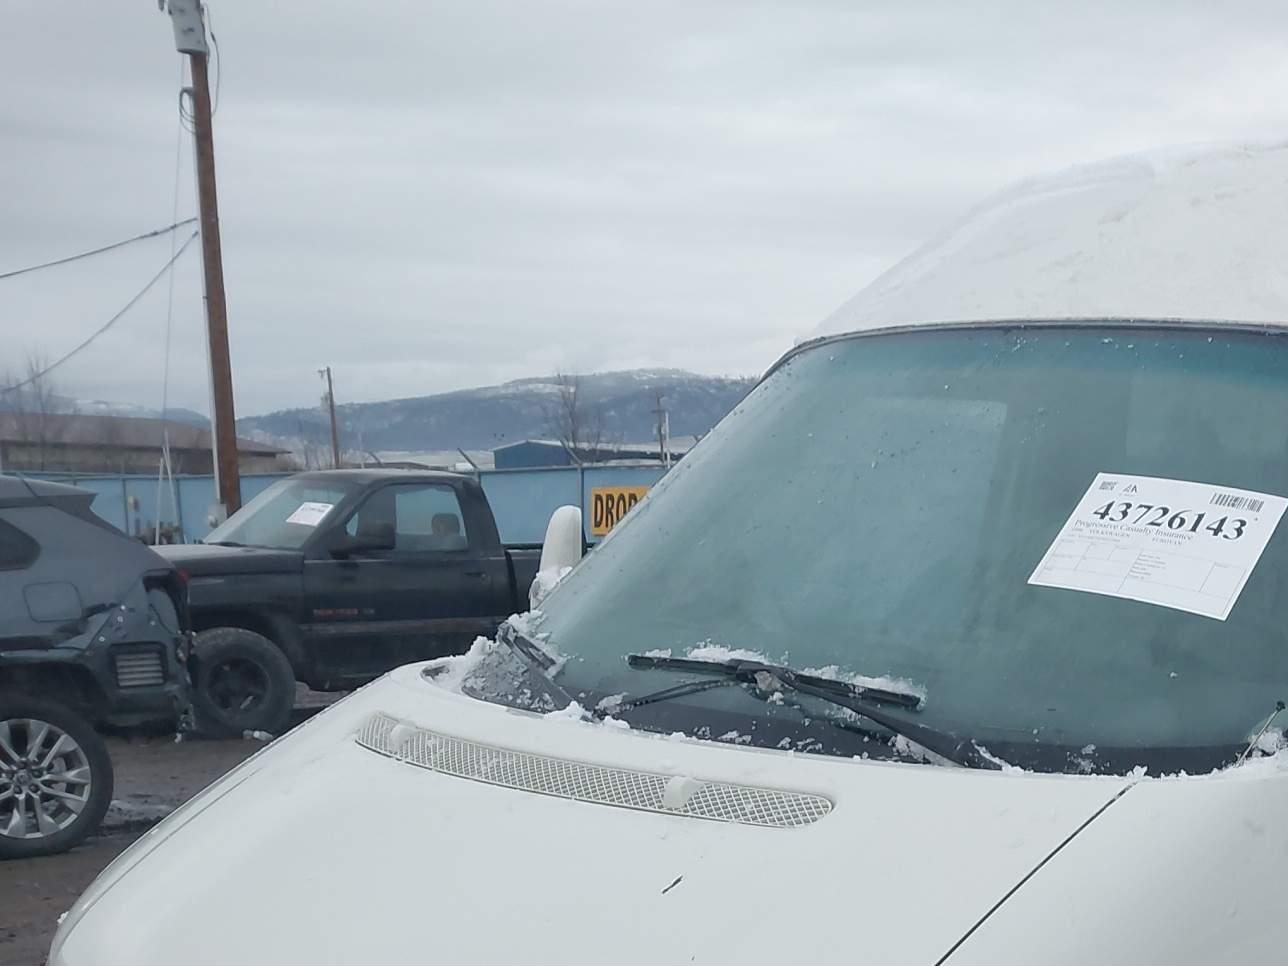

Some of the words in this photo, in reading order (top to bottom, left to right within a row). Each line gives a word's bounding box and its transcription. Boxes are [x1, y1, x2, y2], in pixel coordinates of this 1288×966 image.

[1093, 500, 1248, 540] 43726143
[1119, 523, 1153, 536] Casualty
[1154, 526, 1194, 541] Insurance
